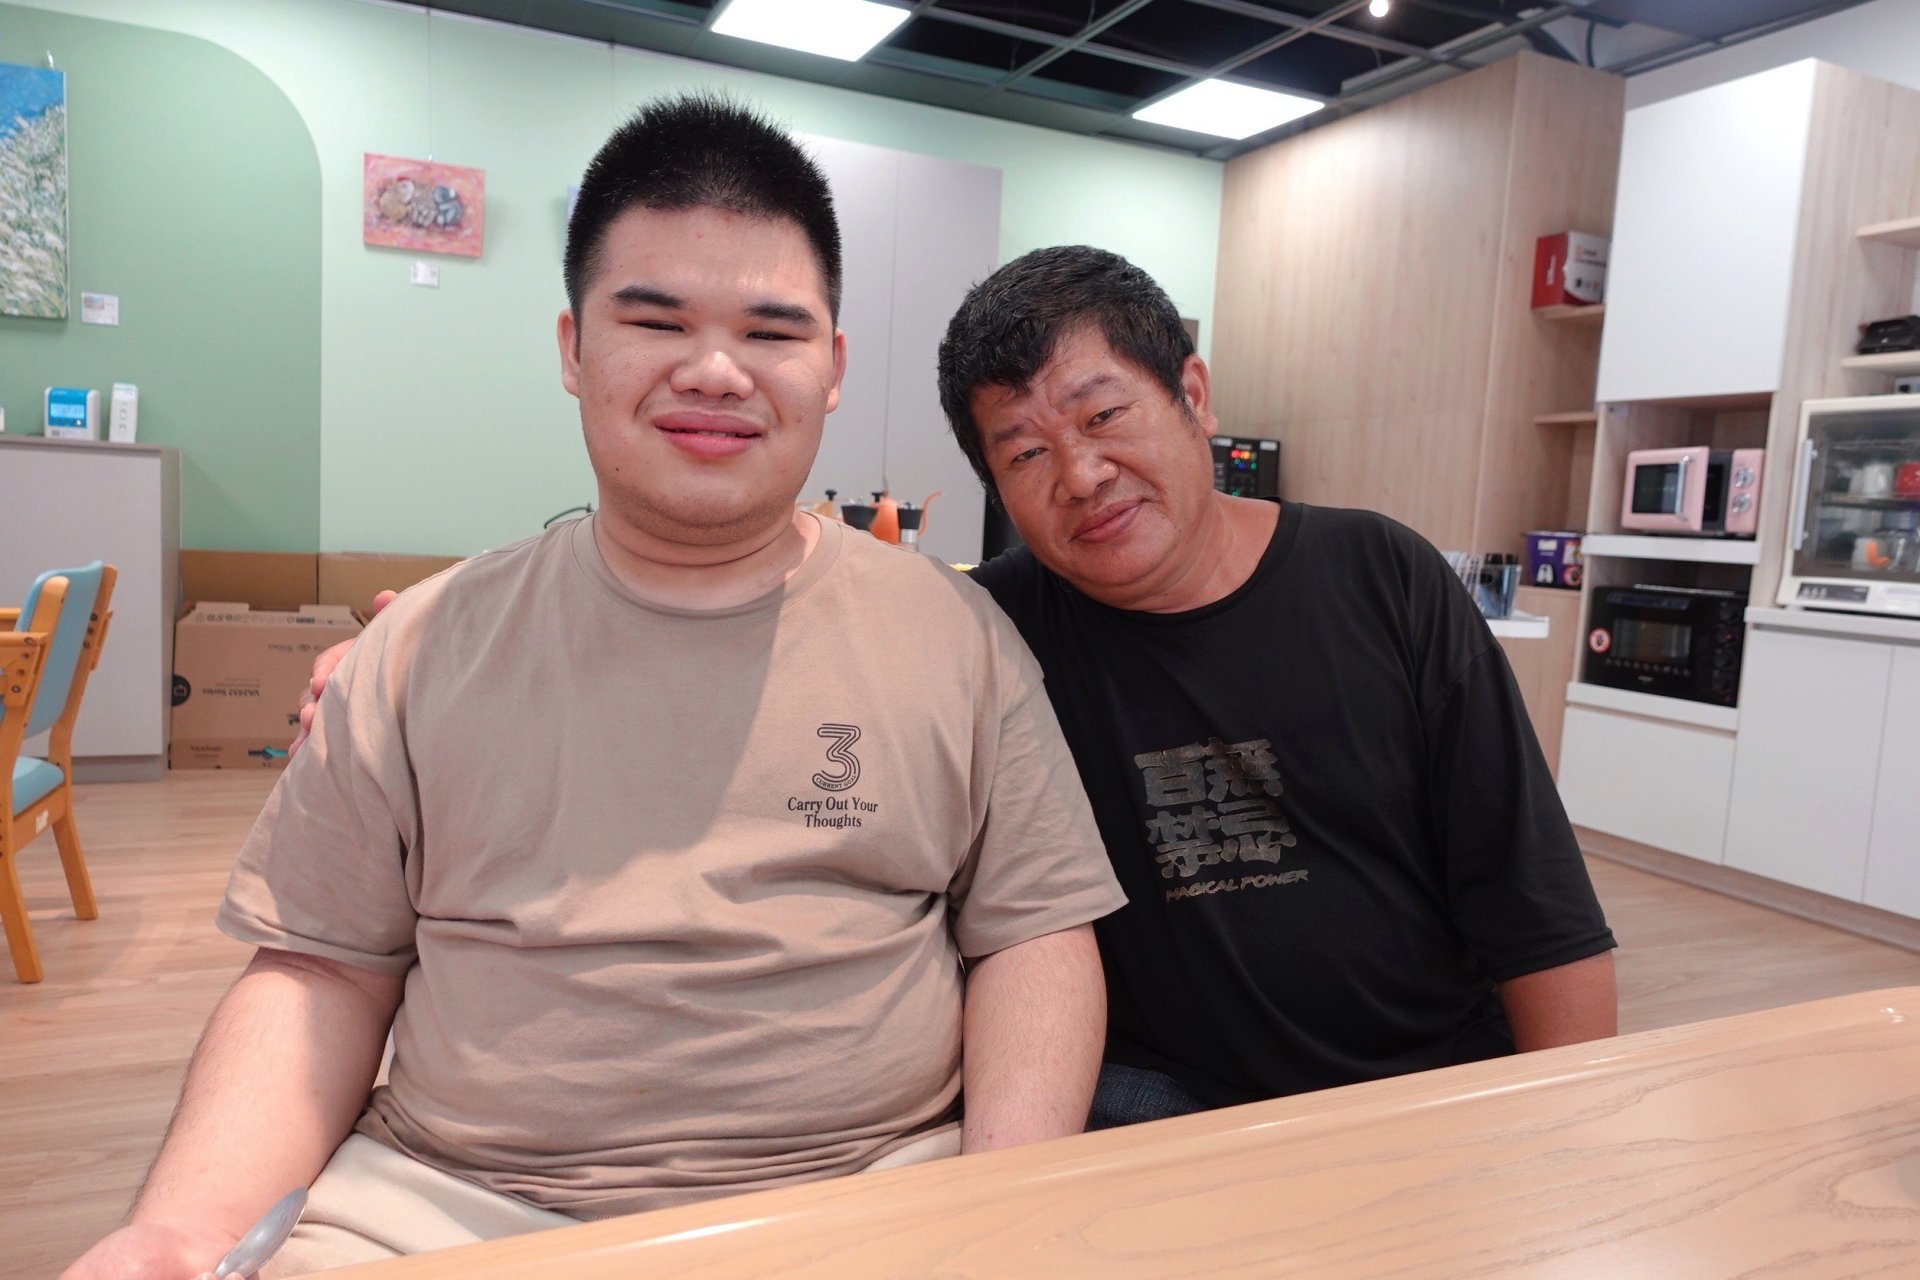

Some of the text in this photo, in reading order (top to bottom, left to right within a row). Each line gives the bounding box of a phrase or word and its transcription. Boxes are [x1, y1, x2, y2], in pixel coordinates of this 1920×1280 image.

[811, 723, 862, 792] 3
[815, 774, 857, 789] CURRENT GOAL
[787, 796, 879, 814] Carry Out Your
[804, 813, 862, 830] Thoughts
[1165, 869, 1310, 903] MAGICAL POWER
